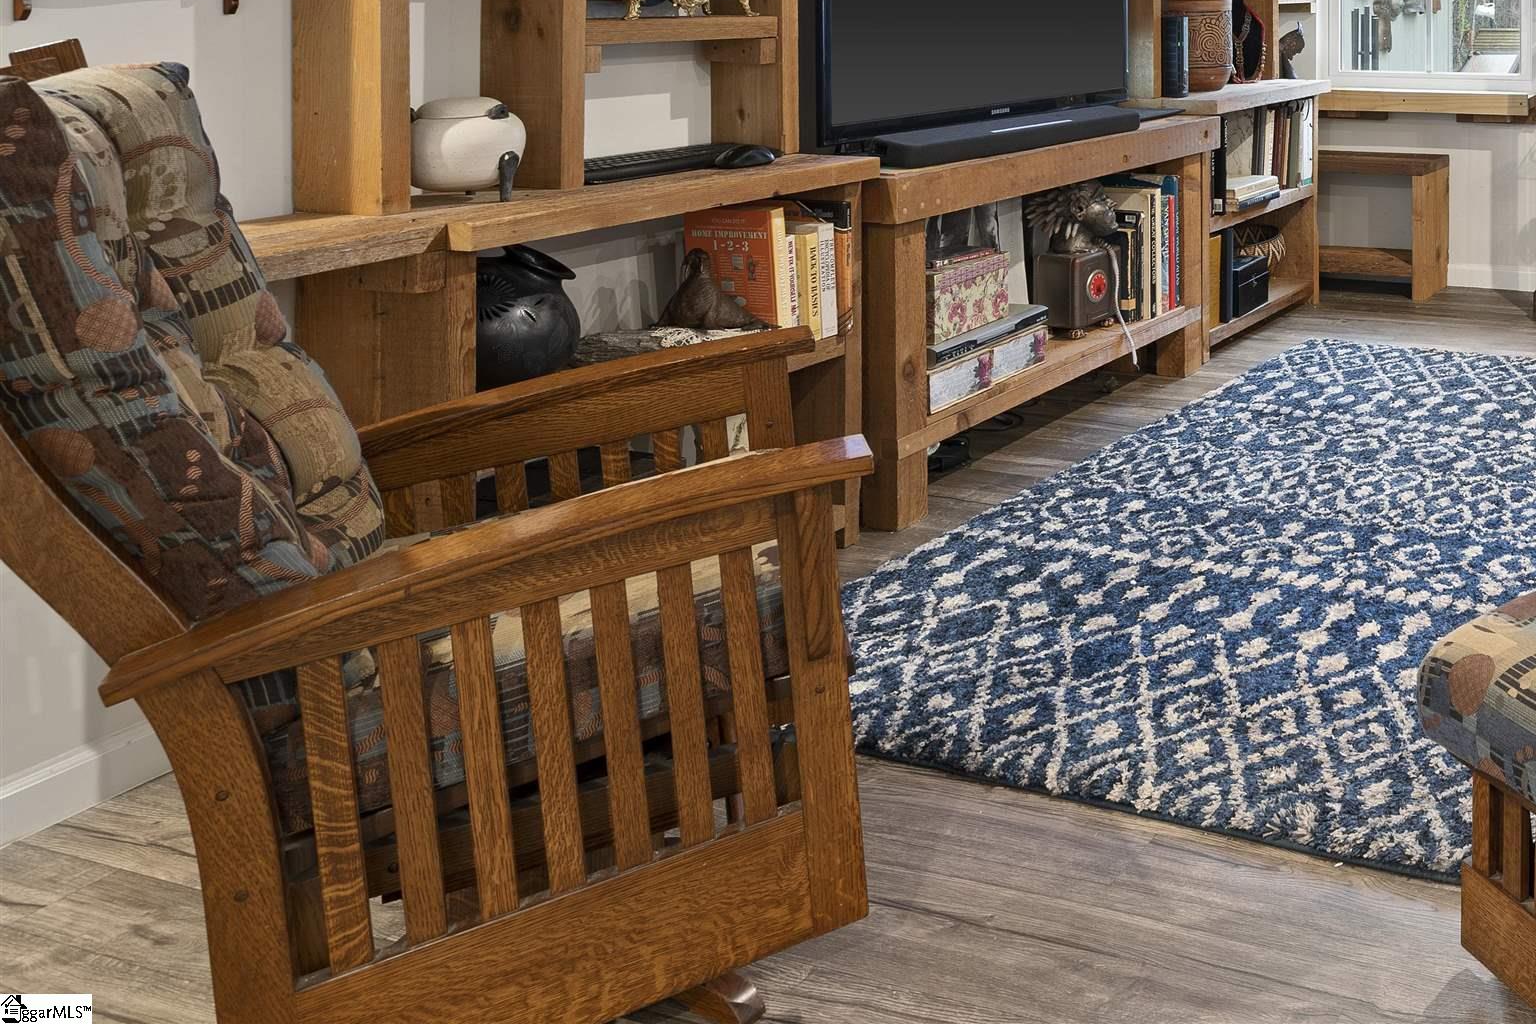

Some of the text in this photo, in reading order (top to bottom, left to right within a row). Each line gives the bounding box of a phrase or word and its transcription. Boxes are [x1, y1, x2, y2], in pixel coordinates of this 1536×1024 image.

[691, 229, 768, 240] HOME IMPROVEMENT
[713, 239, 750, 252] 1-2-3
[809, 246, 819, 317] BACK TO BASICS
